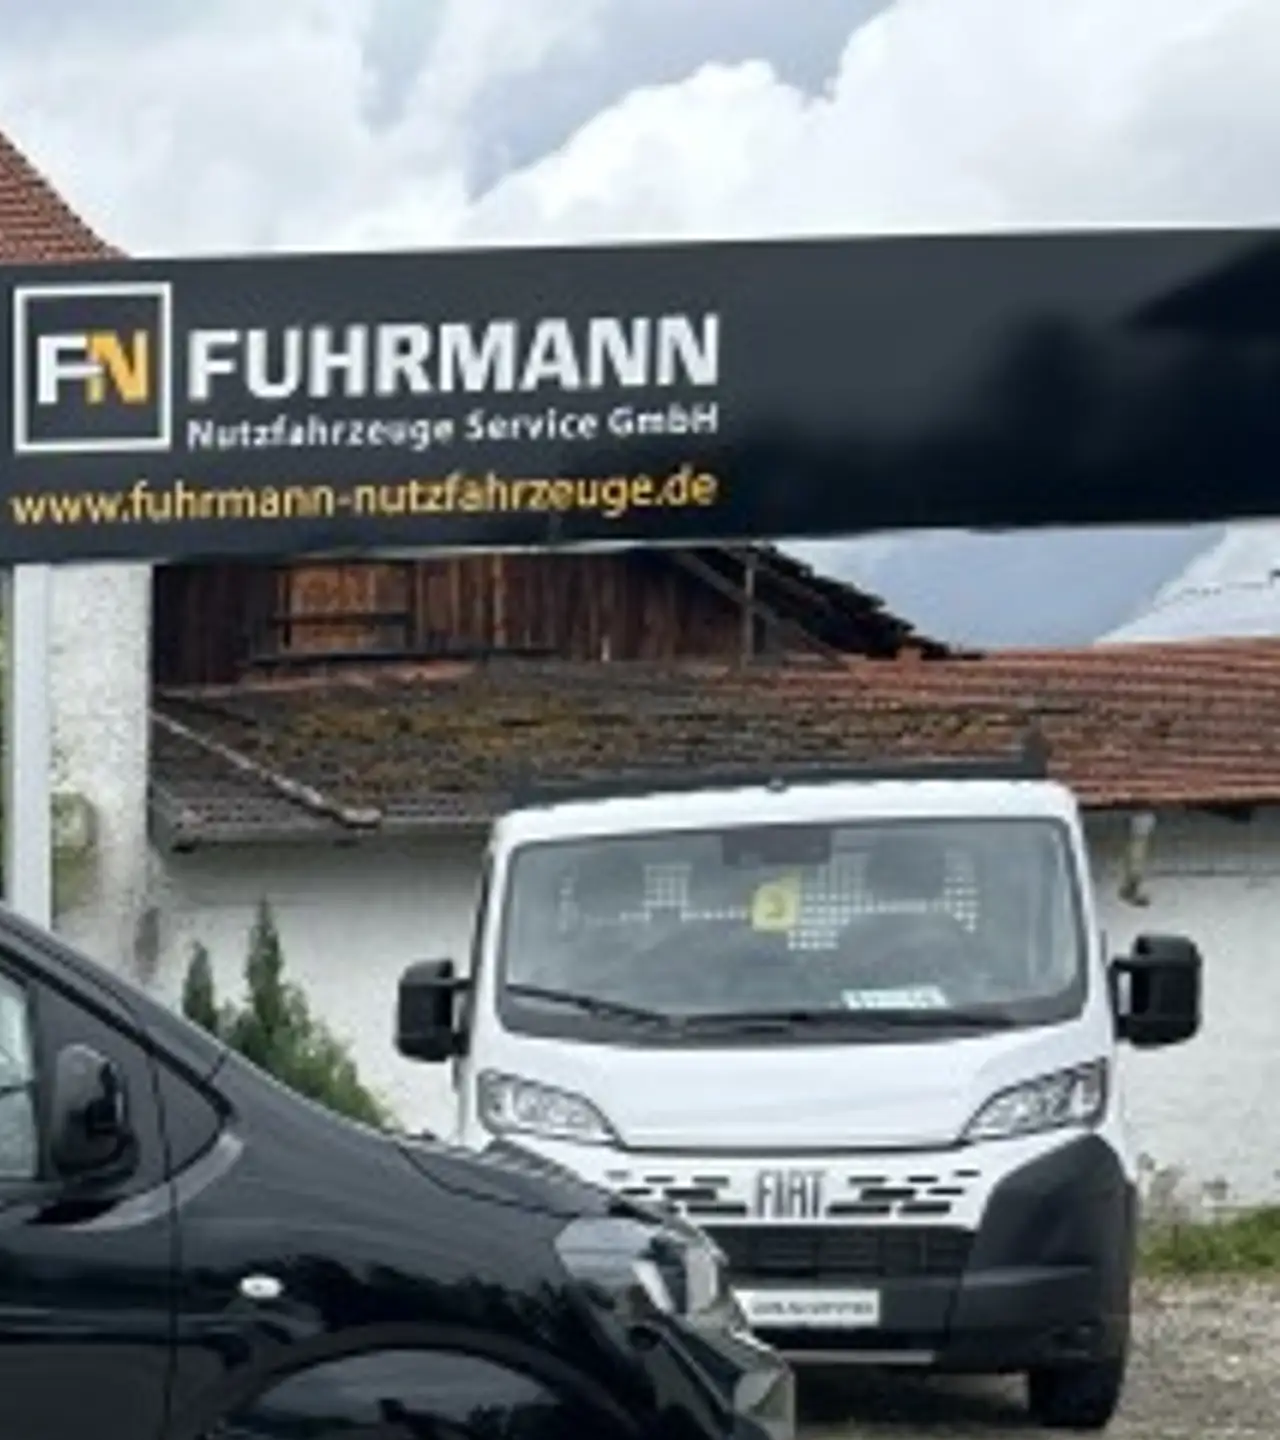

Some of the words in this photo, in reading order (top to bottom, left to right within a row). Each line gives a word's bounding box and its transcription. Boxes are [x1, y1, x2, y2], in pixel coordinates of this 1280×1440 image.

[188, 313, 720, 402] FUHRMANN
[187, 415, 454, 451] Nutzfahrzeuge
[463, 408, 598, 441] Service
[607, 402, 719, 437] GmbH
[10, 465, 720, 524] www.fuhrmann-nutzfahrzeuge.de
[756, 1169, 826, 1218] FIAT
